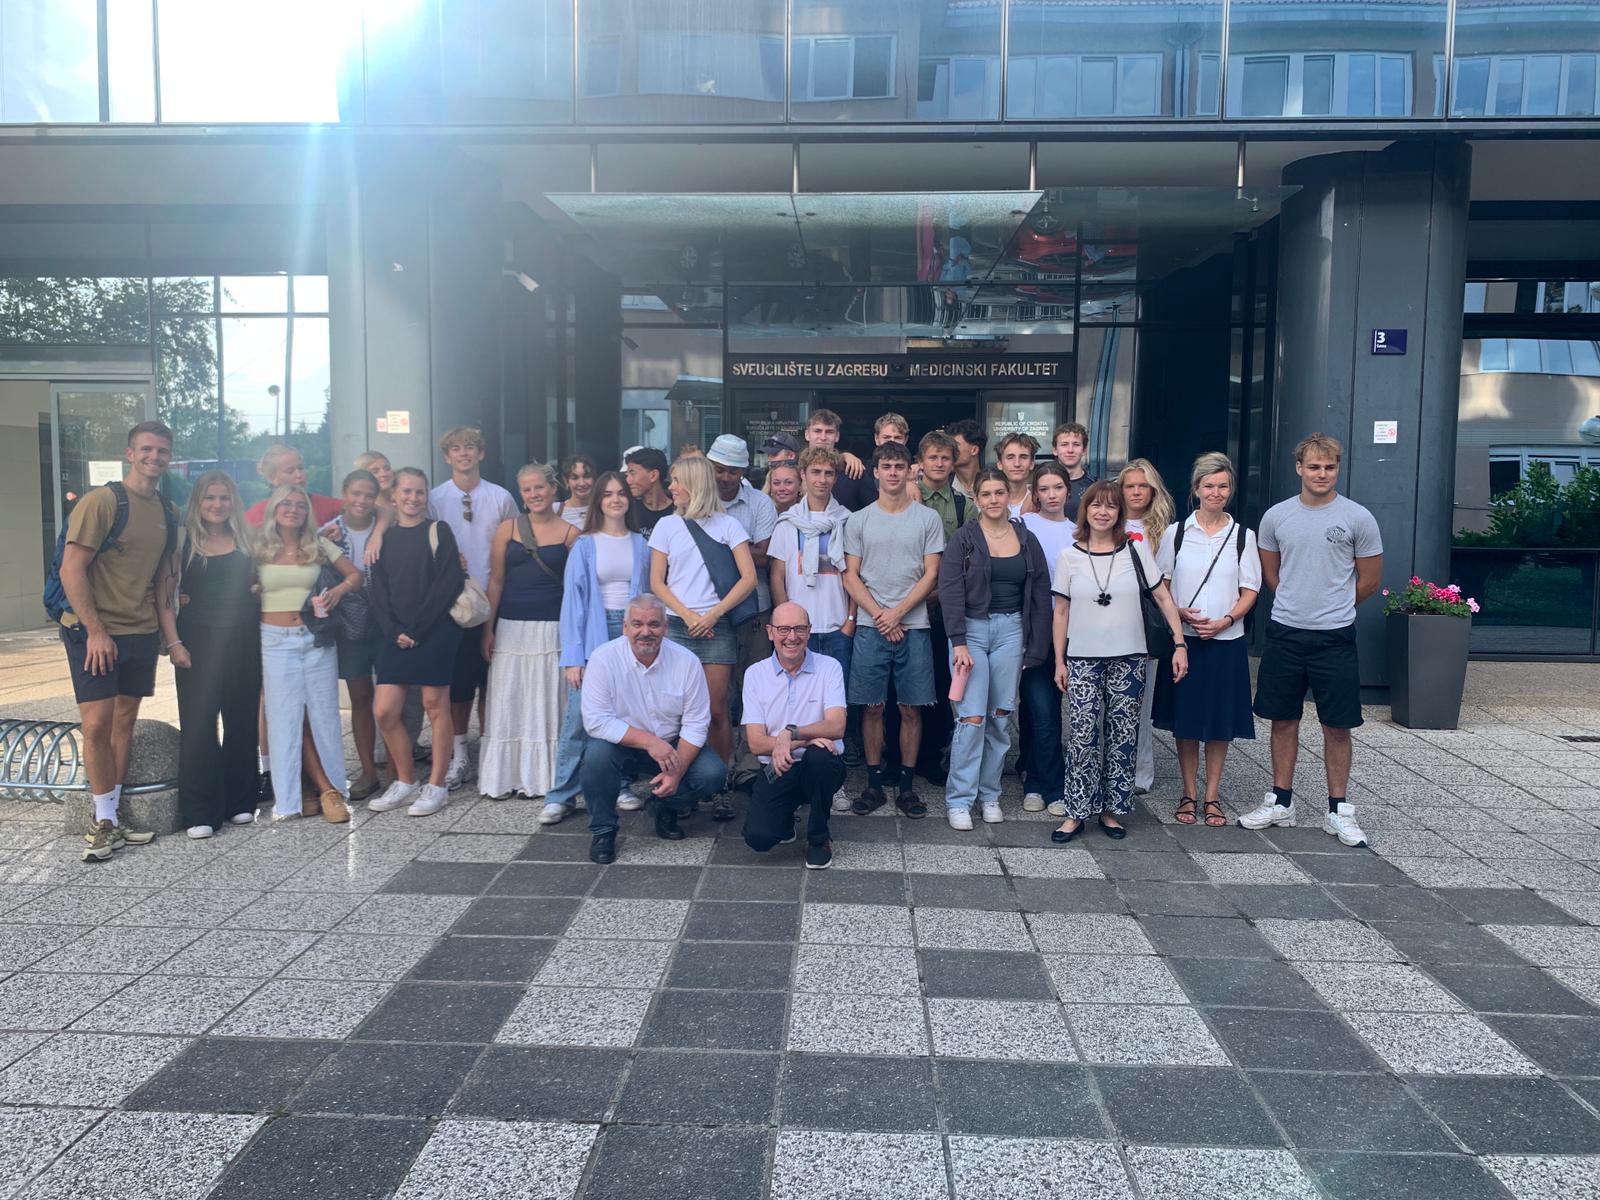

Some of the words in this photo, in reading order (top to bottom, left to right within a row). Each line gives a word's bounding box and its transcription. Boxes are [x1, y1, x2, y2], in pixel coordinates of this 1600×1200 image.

[1377, 332, 1386, 344] 3
[815, 363, 824, 376] U
[827, 363, 888, 377] ZAGREBU
[910, 363, 987, 377] MEDICINSKI
[991, 362, 1059, 376] FAKULTET
